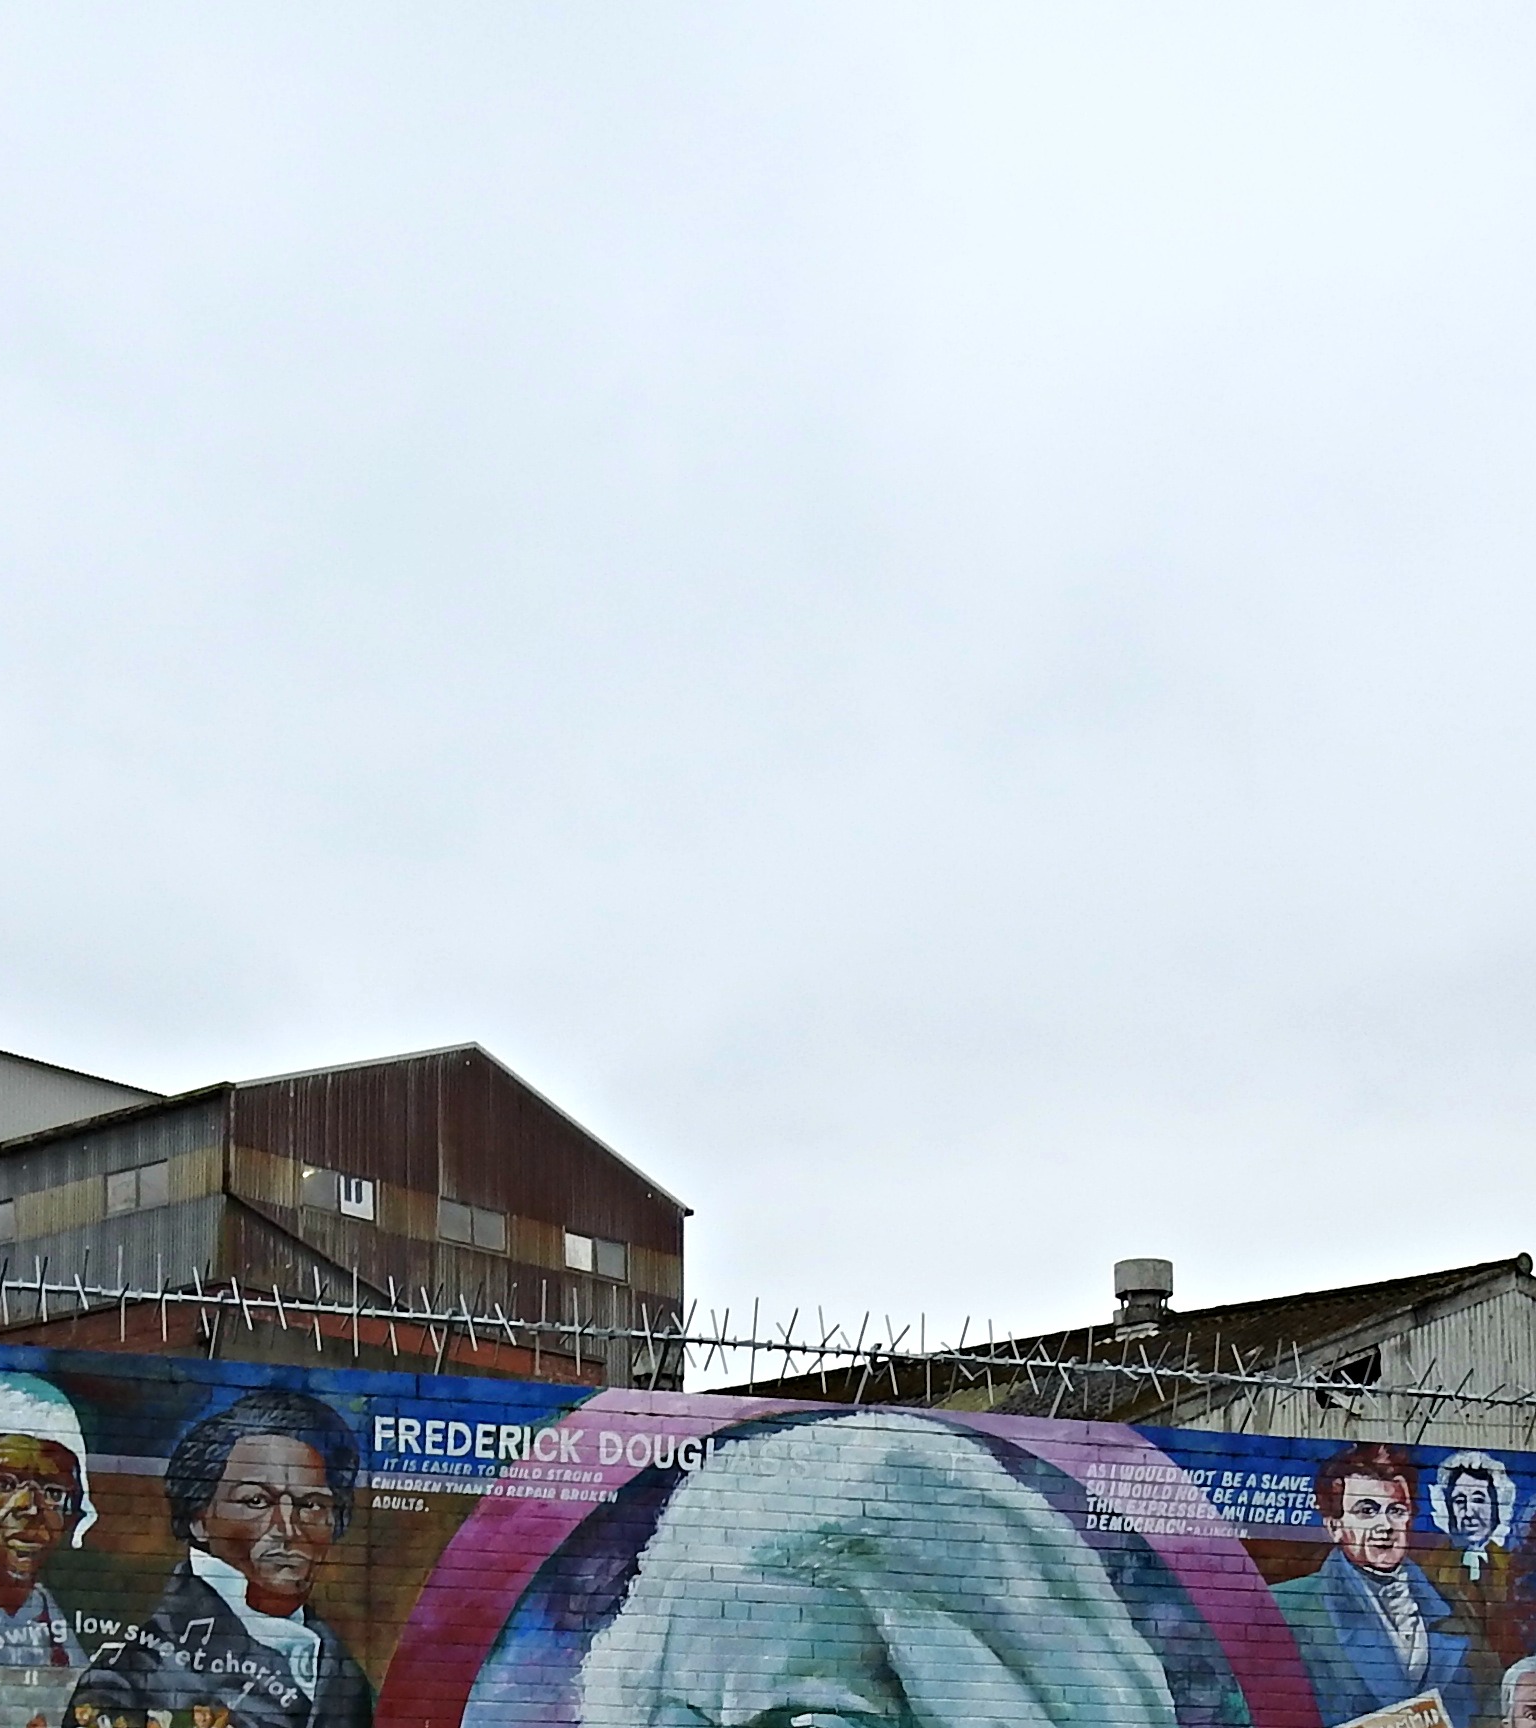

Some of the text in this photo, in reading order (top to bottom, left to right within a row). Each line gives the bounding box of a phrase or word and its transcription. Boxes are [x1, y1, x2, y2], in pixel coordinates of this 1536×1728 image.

[374, 1415, 585, 1464] FREDERICK
[383, 1458, 603, 1483] IT IS EASIER TO BUILD STRONG
[1086, 1463, 1106, 1478] AS
[1109, 1464, 1117, 1479] I
[1120, 1464, 1177, 1482] WOULD
[1181, 1468, 1216, 1486] NOT
[1221, 1471, 1244, 1488] BE
[1245, 1473, 1257, 1488] A
[371, 1477, 619, 1504] CHILDREN THAN TO REPAIR BROKEN
[1085, 1479, 1321, 1510] SO I WOULD NOT BE A MASTER.
[371, 1496, 430, 1513] ADULTS.
[1086, 1497, 1313, 1525] THIS EXPRESSES MY IDEA OF
[75, 1610, 121, 1635] low
[125, 1627, 204, 1670] sweet
[211, 1650, 299, 1708] chariot
